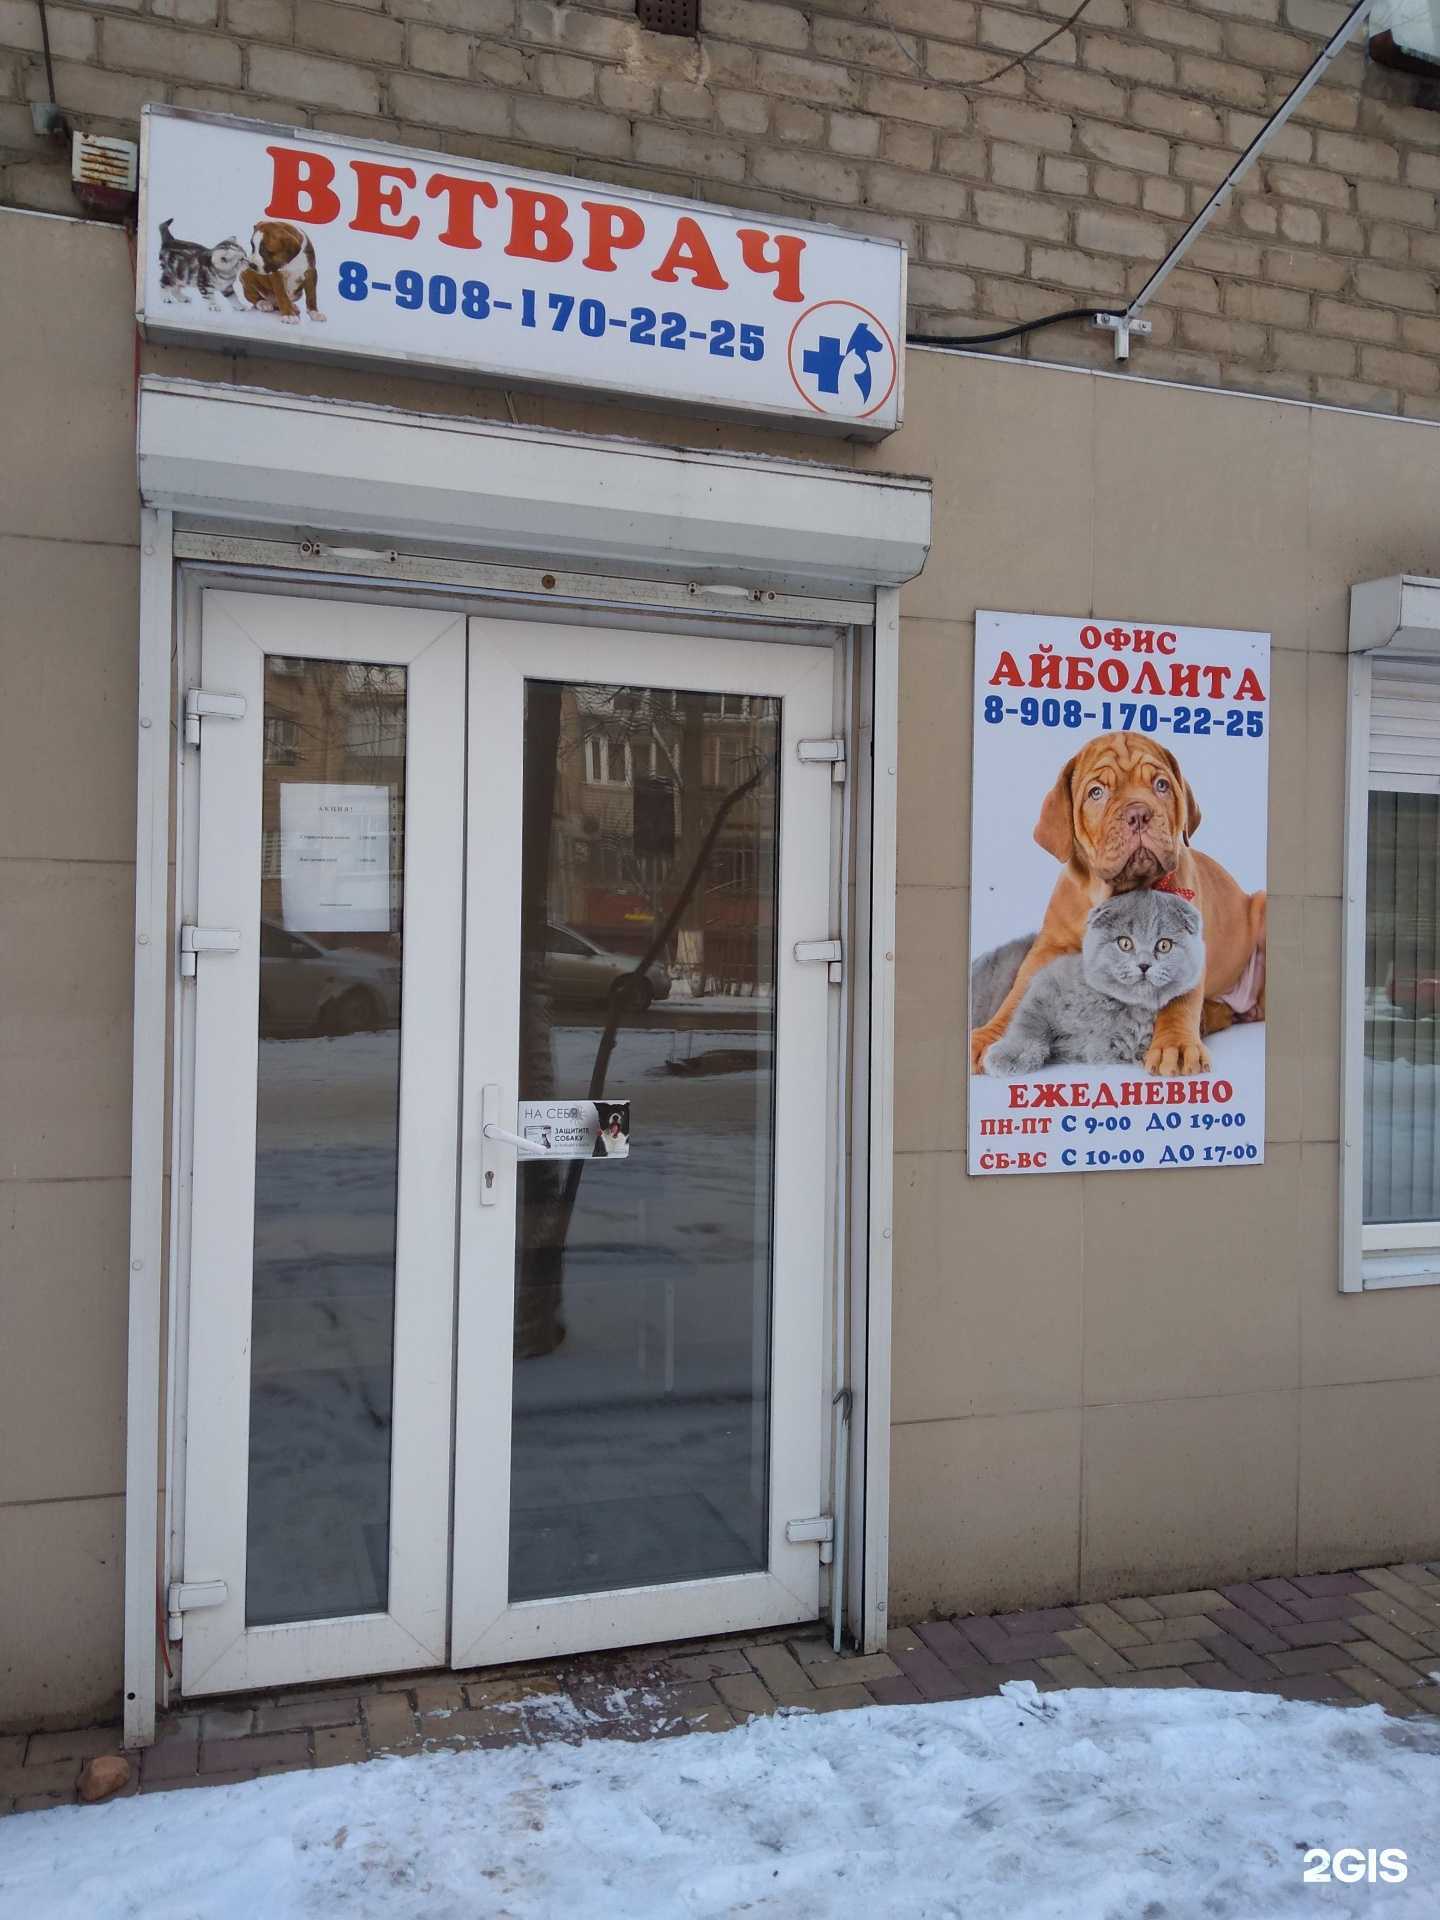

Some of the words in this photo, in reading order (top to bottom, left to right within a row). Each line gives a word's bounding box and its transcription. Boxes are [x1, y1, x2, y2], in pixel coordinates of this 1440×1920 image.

[265, 146, 806, 302] ВЕТВРАЧ
[338, 261, 765, 361] 8-908-170-22-25
[1079, 625, 1177, 655] ОФИС
[988, 643, 1266, 702] АЙБОЛИТА
[984, 695, 1264, 738] 8-908-170-22-25
[1008, 1080, 1233, 1109] ЕЖЕДНЕВНО
[524, 1108, 542, 1119] НА
[980, 1117, 1052, 1135] ПН-ПТ
[1061, 1115, 1077, 1132] С
[1084, 1116, 1131, 1133] 9-00
[1145, 1112, 1182, 1131] ДО
[1189, 1113, 1246, 1130] 19-00
[979, 1151, 1047, 1169] СБ-ВС
[1061, 1149, 1077, 1166] С
[1085, 1149, 1145, 1165] 10-00
[1159, 1145, 1195, 1164] ДО
[1203, 1145, 1257, 1162] 17-00
